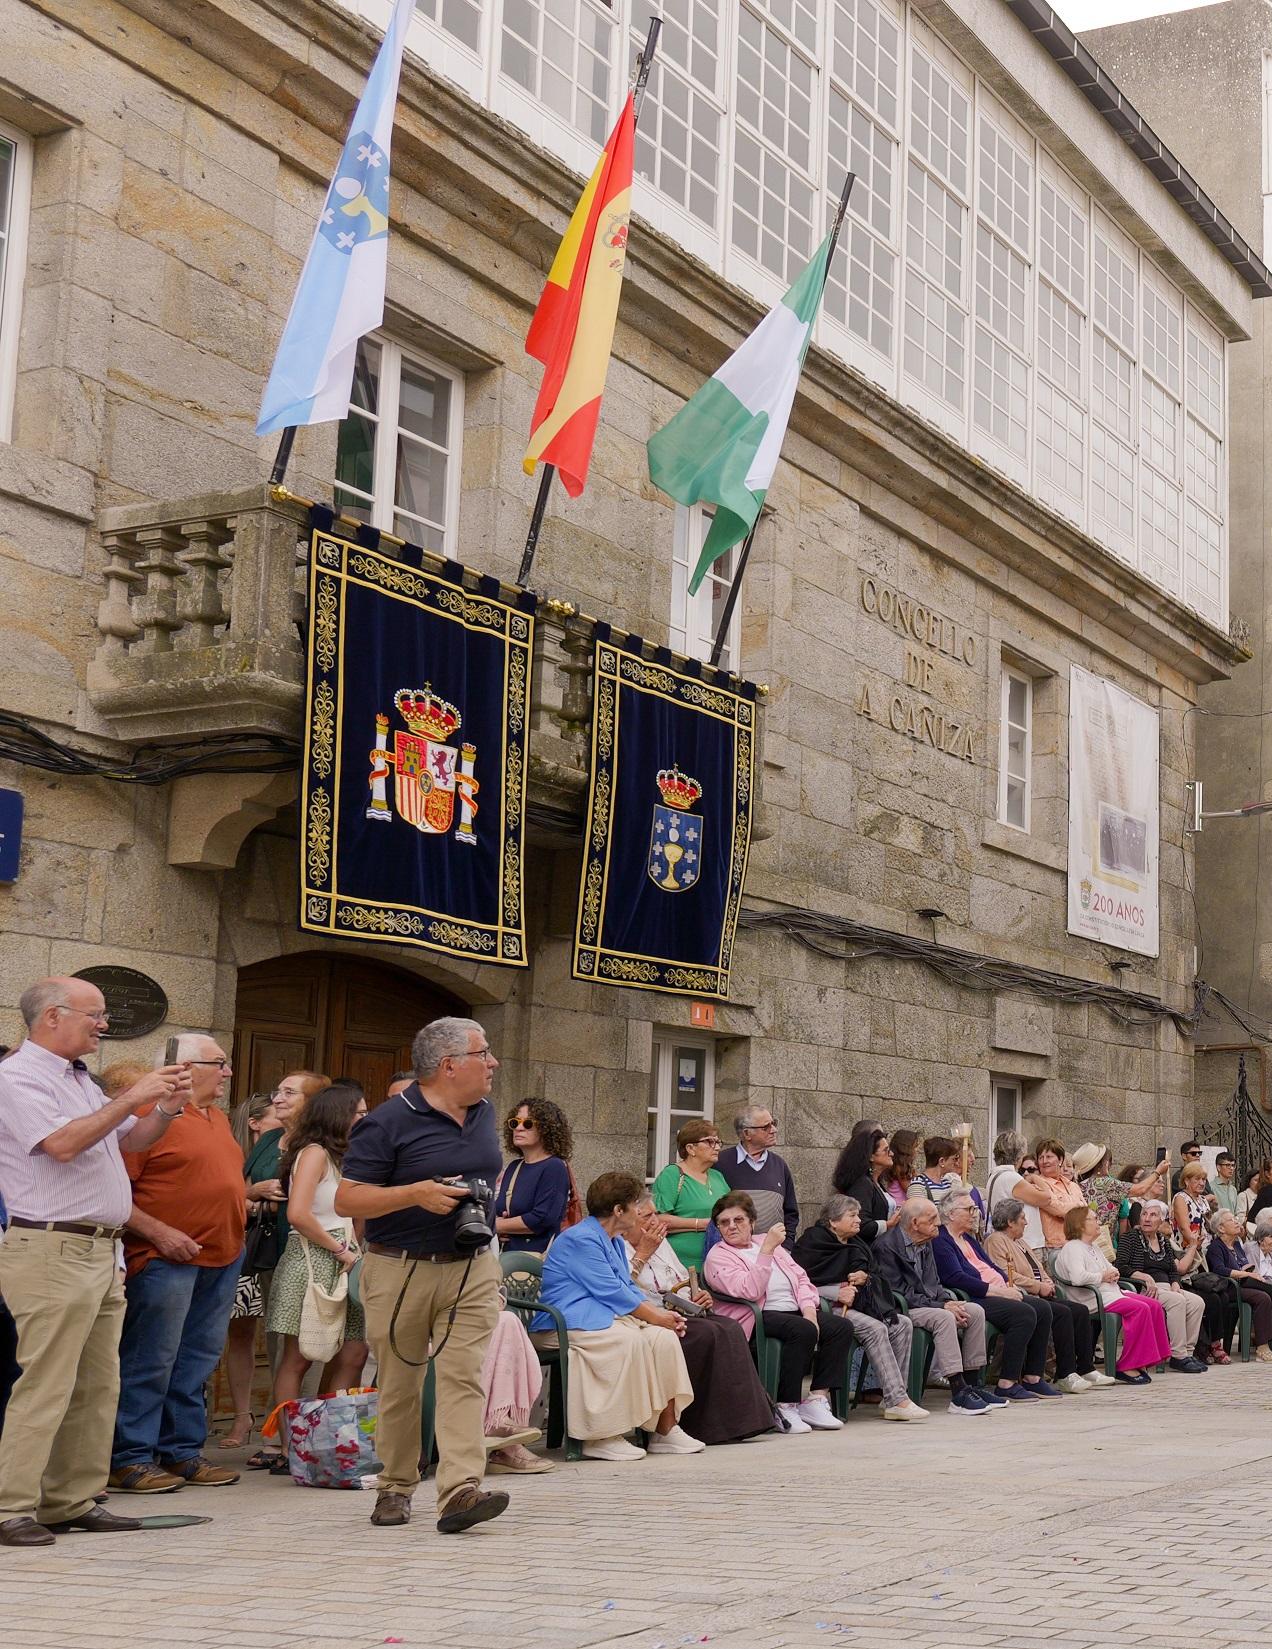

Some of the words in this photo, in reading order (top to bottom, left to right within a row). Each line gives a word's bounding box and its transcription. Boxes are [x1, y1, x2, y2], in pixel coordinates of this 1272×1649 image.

[862, 578, 976, 666] CONCELLO
[906, 652, 933, 694] DE
[857, 683, 873, 719] A
[889, 697, 975, 763] CAÑIZA
[1093, 893, 1113, 916] 200
[1116, 901, 1144, 927] ANOS
